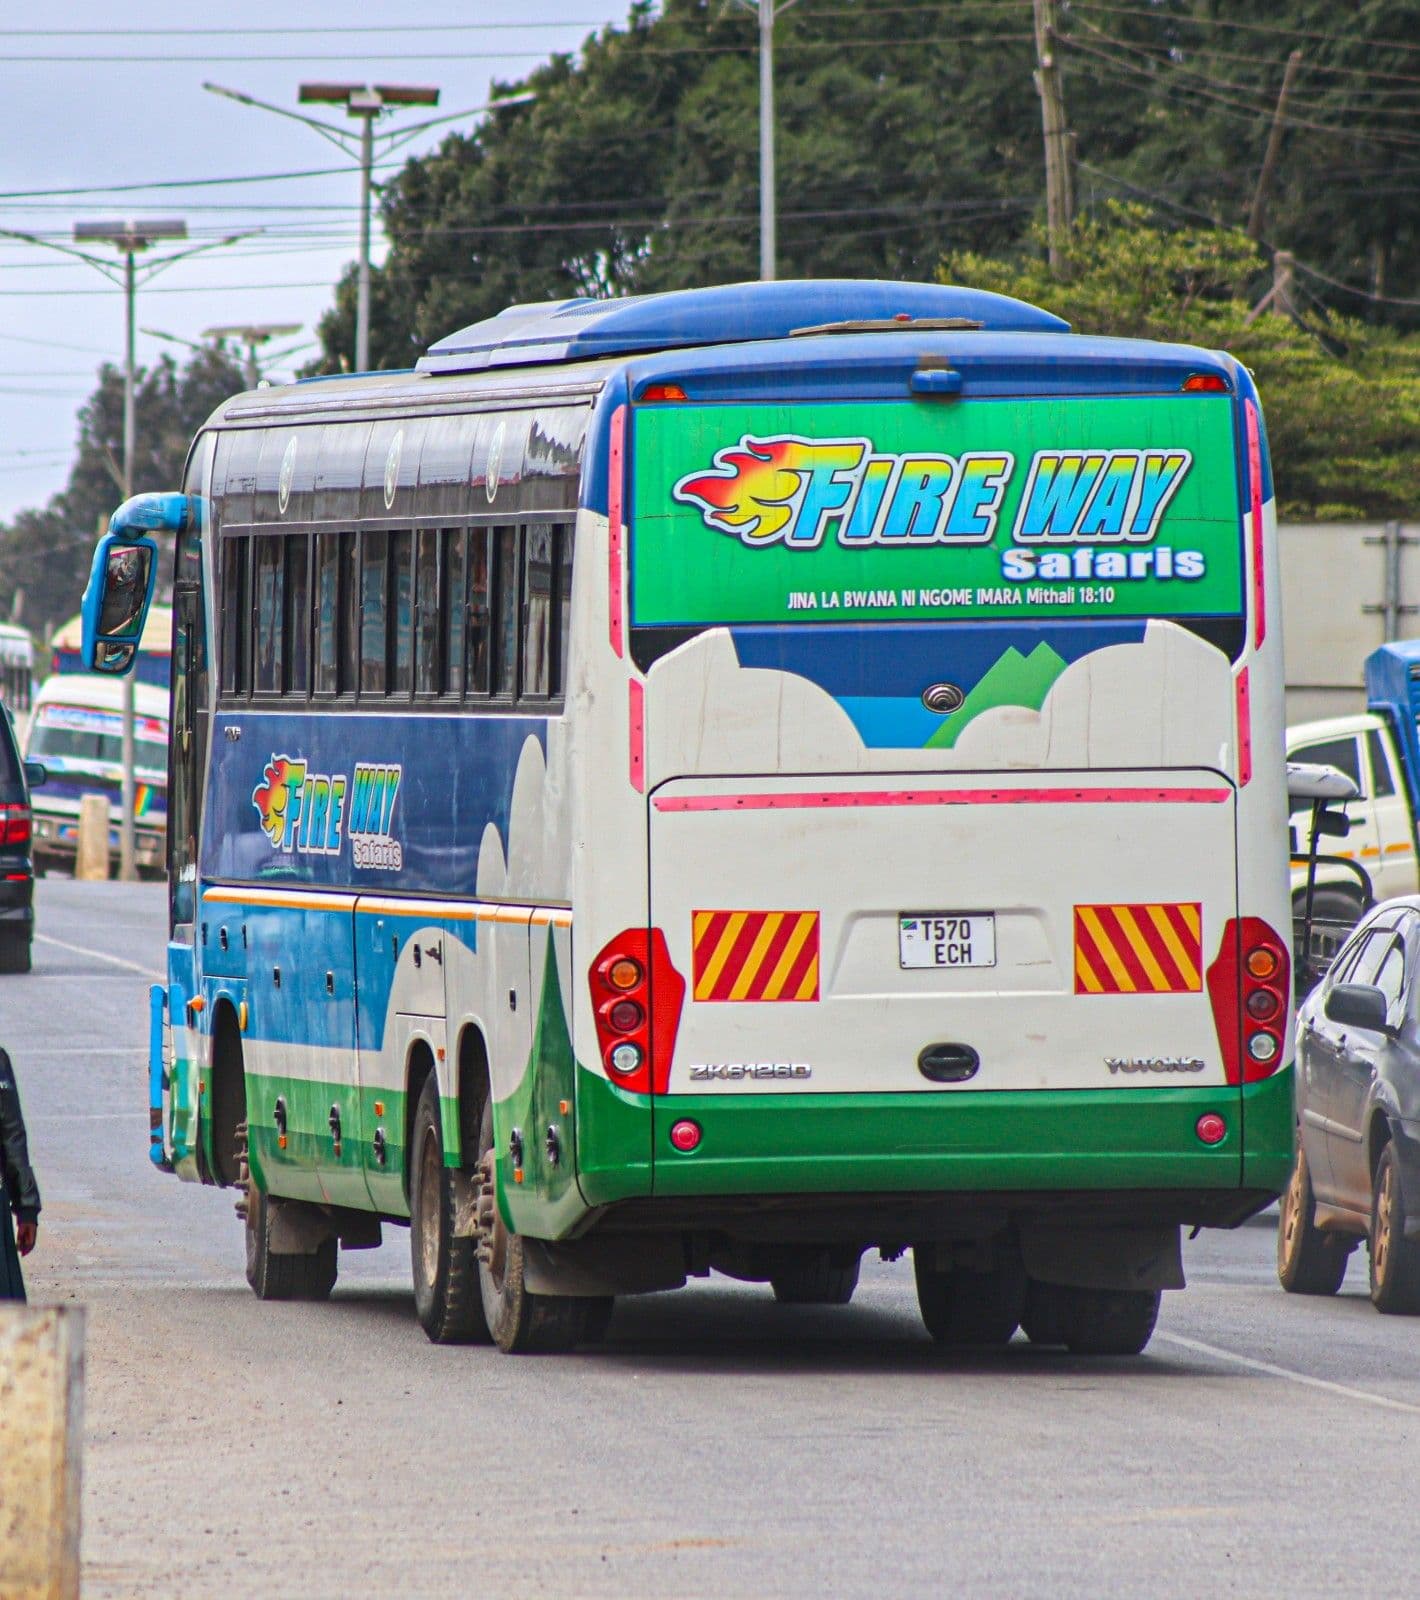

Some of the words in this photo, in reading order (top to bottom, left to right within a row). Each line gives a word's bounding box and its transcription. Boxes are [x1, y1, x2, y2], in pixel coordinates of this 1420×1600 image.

[776, 439, 1010, 541] FIRE
[1019, 455, 1187, 536] WAY
[1002, 547, 1206, 580] Safaris
[788, 592, 817, 609] JINA
[821, 591, 840, 608] LA
[844, 590, 897, 607] BWANA
[901, 589, 916, 606] NI
[919, 588, 973, 606] NGOME
[976, 587, 1022, 605] IMARA
[1026, 586, 1075, 604] Mithali
[1079, 586, 1115, 603] 18:10
[275, 761, 347, 852] FIRE
[350, 766, 400, 836] WAY
[353, 840, 402, 869] Safaris
[921, 919, 971, 941] T570
[934, 943, 972, 964] ECH
[1104, 1056, 1206, 1074] YUTONG
